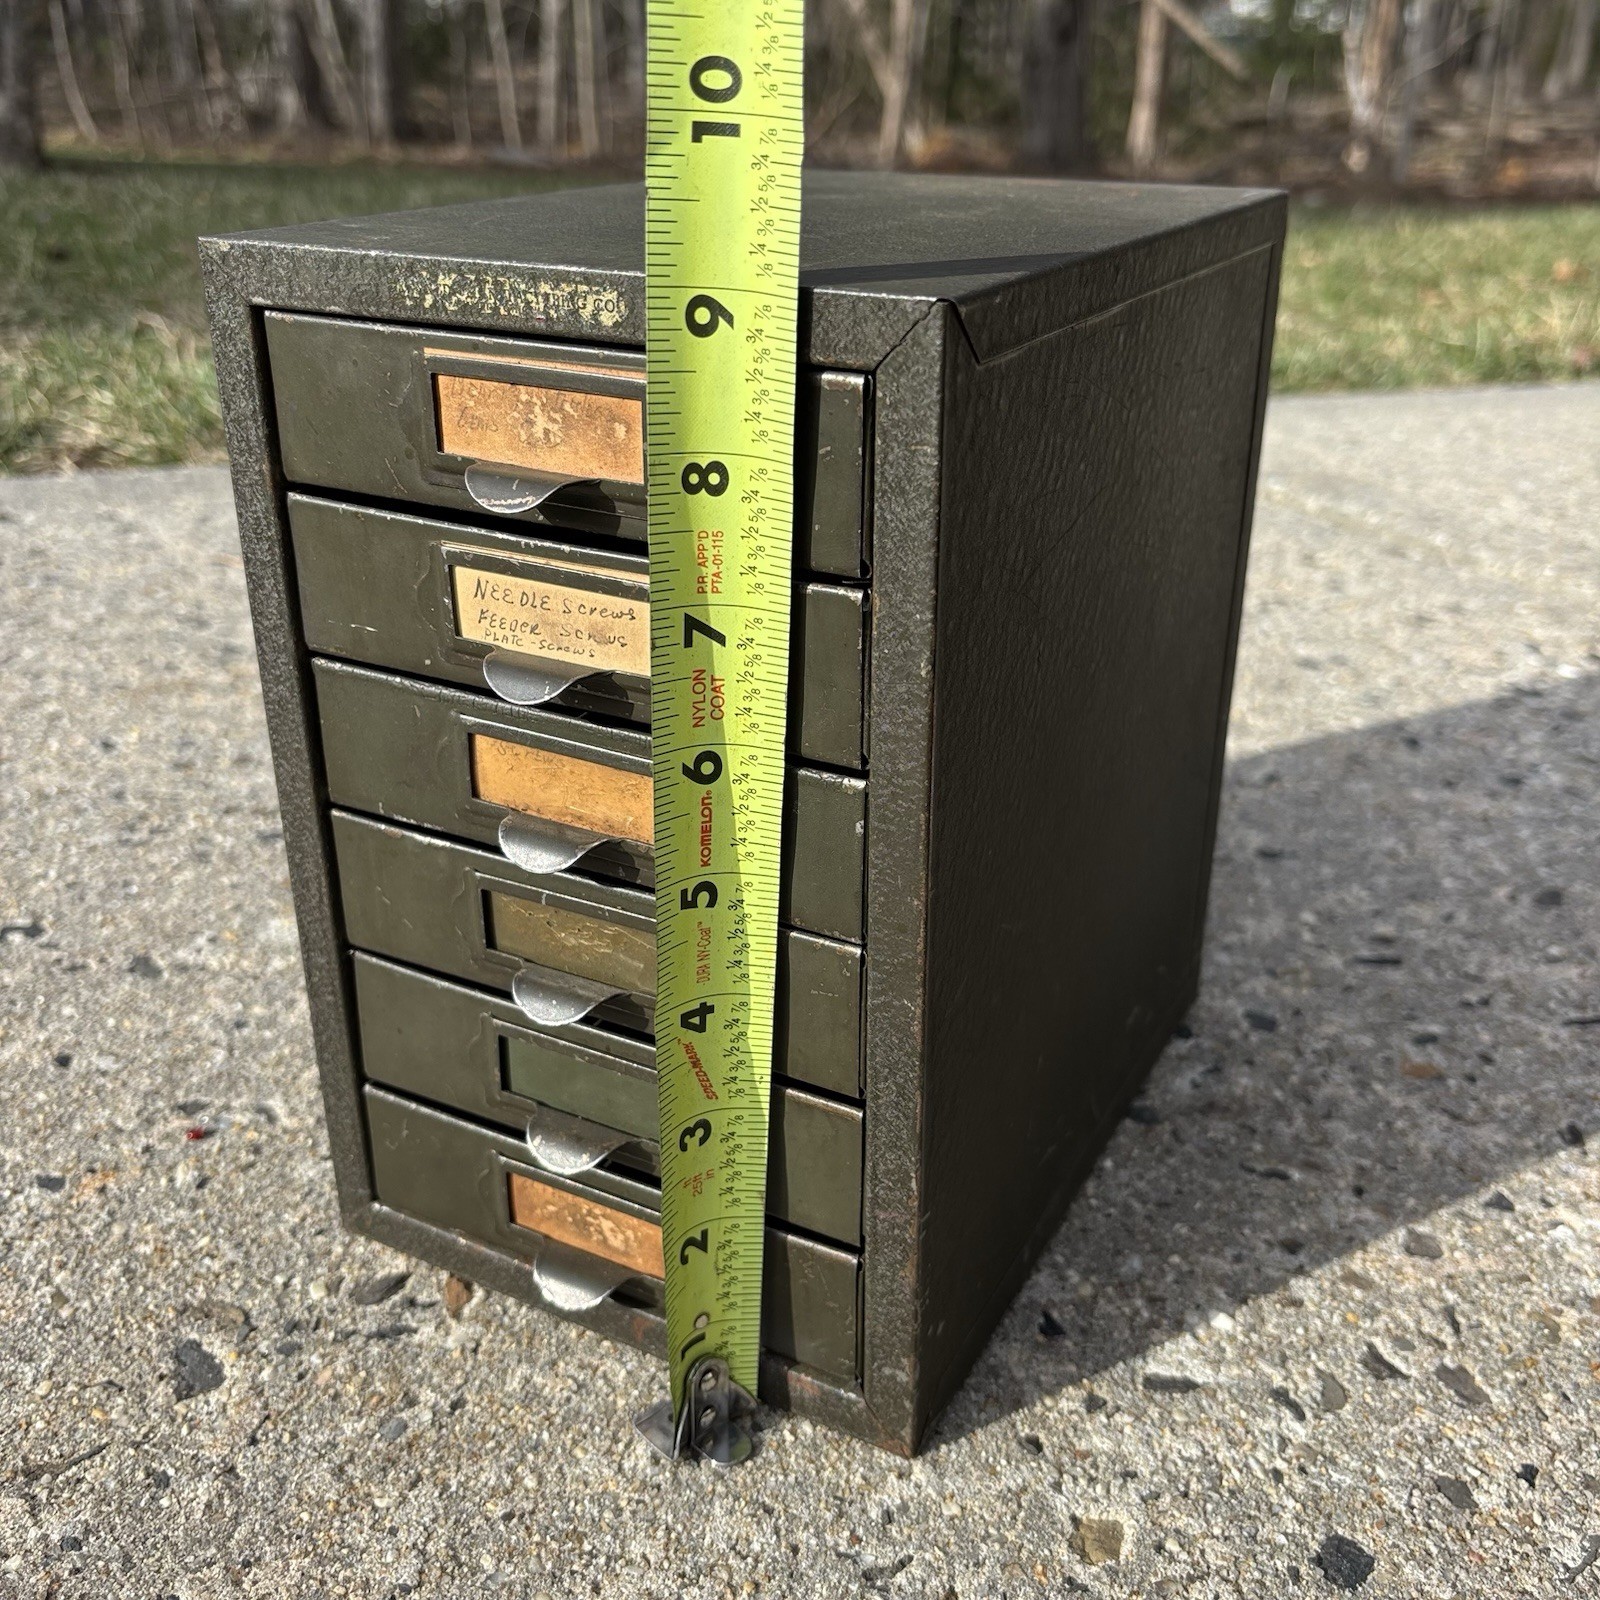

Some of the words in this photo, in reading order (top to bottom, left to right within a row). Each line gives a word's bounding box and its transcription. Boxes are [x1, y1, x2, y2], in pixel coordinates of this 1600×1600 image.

[755, 12, 773, 29] 1/2
[762, 36, 779, 54] 3/8
[754, 62, 772, 76] 1/4
[761, 84, 778, 99] 1/8
[689, 55, 743, 143] 10
[759, 128, 778, 144] 7/8
[751, 154, 770, 170] 3/4
[758, 175, 777, 192] 5/8
[750, 197, 769, 213] 1/2
[757, 219, 775, 236] 3/8
[748, 243, 767, 256] 1/4
[755, 263, 773, 278] 1/8
[685, 294, 734, 338] 9
[754, 305, 772, 320] 7/8
[746, 328, 764, 343] 3/4
[753, 348, 770, 364] 5/8
[745, 369, 764, 384] 1/2
[752, 389, 769, 405] 3/8
[744, 410, 762, 424] 1/4
[751, 430, 768, 444] 1/8
[681, 460, 730, 497] 8
[750, 468, 768, 482] 7/8
[741, 489, 760, 504] 3/4
[749, 508, 767, 522] 5/8
[741, 526, 759, 541] 1/2
[748, 545, 765, 560] 3/8
[711, 530, 724, 594] PTA-01-115
[739, 564, 758, 578] 1/4
[746, 583, 765, 596] 1/8
[473, 576, 551, 612] NEEDLE
[562, 597, 637, 621] Screws
[684, 612, 726, 648] 7
[745, 617, 763, 630] 7/8
[737, 637, 755, 650] 3/4
[744, 654, 762, 667] 5/8
[736, 671, 755, 685] 1/2
[692, 669, 707, 728] NYLON
[710, 674, 726, 721] COAT
[743, 688, 761, 702] 3/8
[735, 706, 753, 718] 1/4
[741, 722, 760, 734] 1/8
[682, 750, 723, 785] 6
[740, 754, 758, 767] 7/8
[732, 773, 750, 785] 3/4
[739, 788, 757, 801] 5/8
[731, 804, 749, 817] 1/2
[738, 820, 756, 833] 3/8
[730, 837, 748, 848] 1/4
[737, 852, 755, 863] 1/8
[736, 881, 753, 893] 7/8
[680, 881, 718, 910] 5
[728, 898, 745, 911] 3/4
[734, 913, 752, 925] 5/8
[727, 928, 745, 940] 1/2
[734, 942, 751, 955] 3/8
[726, 960, 743, 970] 1/4
[733, 973, 750, 984] 1/8
[731, 1001, 748, 1014] 7/8
[680, 1001, 715, 1033] 4
[723, 1018, 741, 1030] 3/4
[730, 1030, 748, 1043] 5/8
[723, 1046, 740, 1058] 1/2
[729, 1059, 746, 1072] 3/8
[722, 1075, 739, 1086] 1/4
[679, 1118, 712, 1152] 3
[680, 1228, 709, 1266] 2
[681, 1332, 706, 1362] 1
